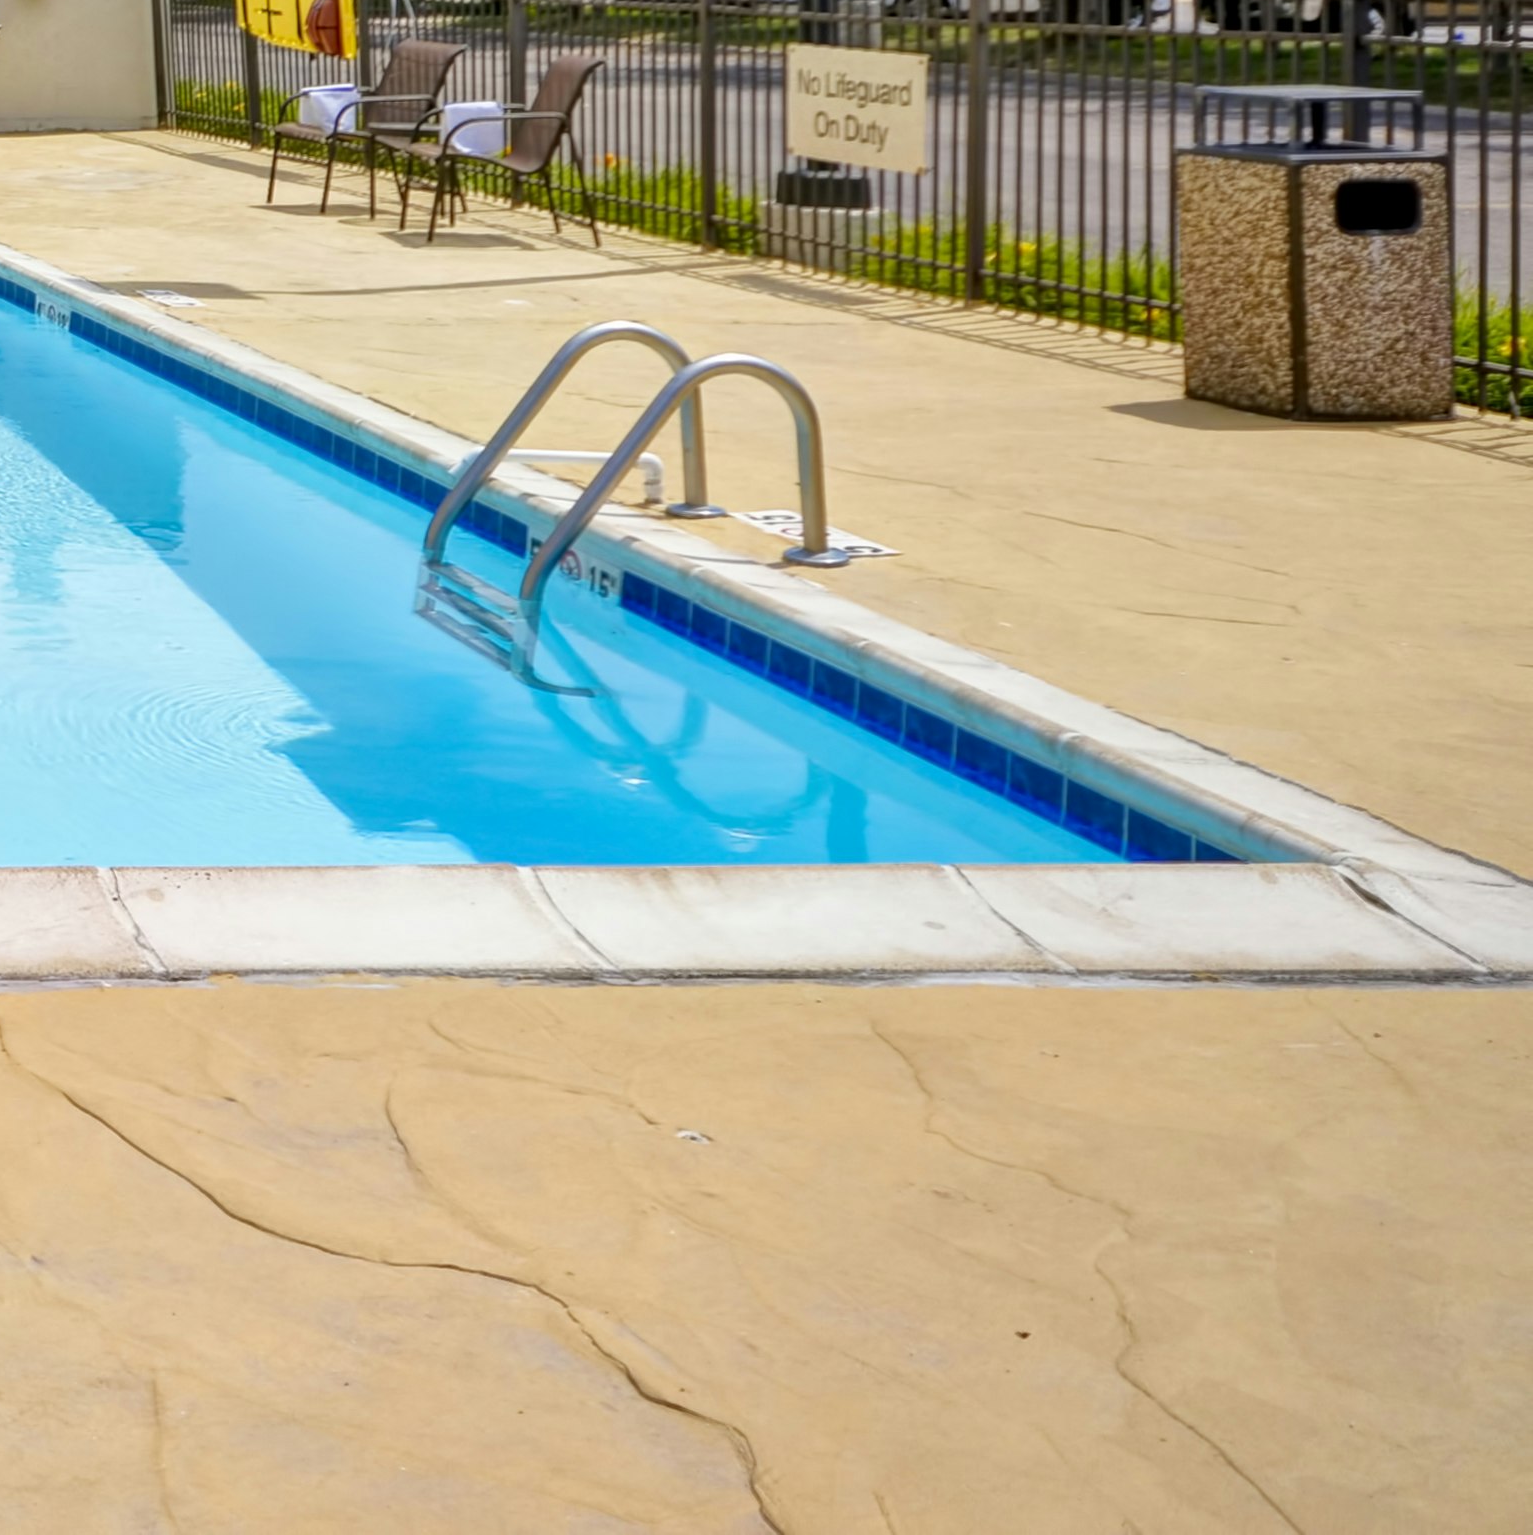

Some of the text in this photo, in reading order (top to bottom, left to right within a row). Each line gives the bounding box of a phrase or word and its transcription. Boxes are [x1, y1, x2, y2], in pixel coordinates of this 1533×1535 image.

[797, 68, 913, 109] No Lifeguard
[815, 110, 890, 153] On Duty
